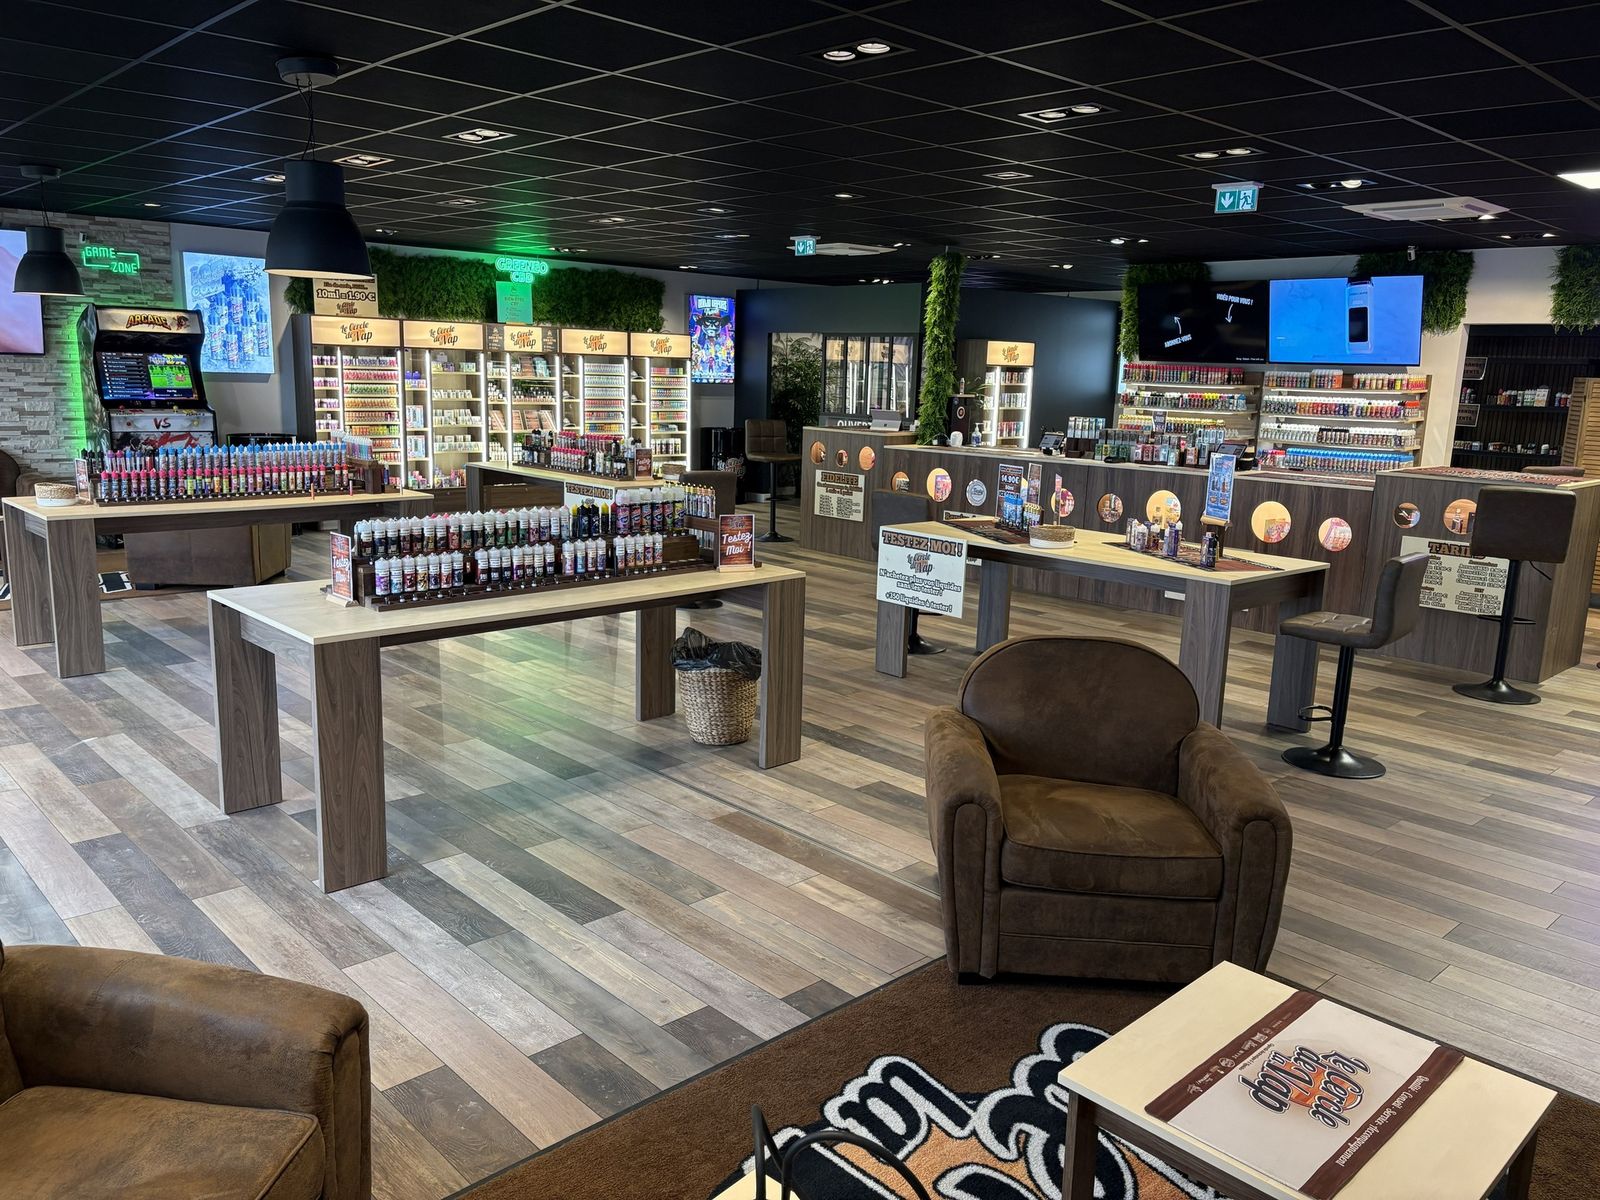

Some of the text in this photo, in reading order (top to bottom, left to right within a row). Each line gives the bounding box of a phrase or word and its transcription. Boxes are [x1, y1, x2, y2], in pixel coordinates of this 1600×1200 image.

[85, 246, 116, 258] GAME
[111, 262, 138, 274] ZONE
[317, 288, 340, 299] 10ml
[125, 314, 172, 331] ARCADE
[153, 417, 171, 430] VS
[566, 482, 594, 497] TESTEZ
[593, 487, 610, 500] MOI
[722, 530, 753, 545] Testez
[882, 530, 964, 557] TESTEZ MOI !
[726, 543, 745, 556] Moi
[909, 574, 923, 586] plus
[935, 579, 962, 593] liquides
[900, 593, 925, 605] liquides
[930, 602, 948, 612] tester
[1269, 1050, 1288, 1066] la
[1290, 1044, 1327, 1071] de
[1237, 1060, 1315, 1114] Vap
[1308, 1050, 1371, 1130] Le Cercle
[1335, 1074, 1430, 1168] Qualité Conseil Service Accompagnement
